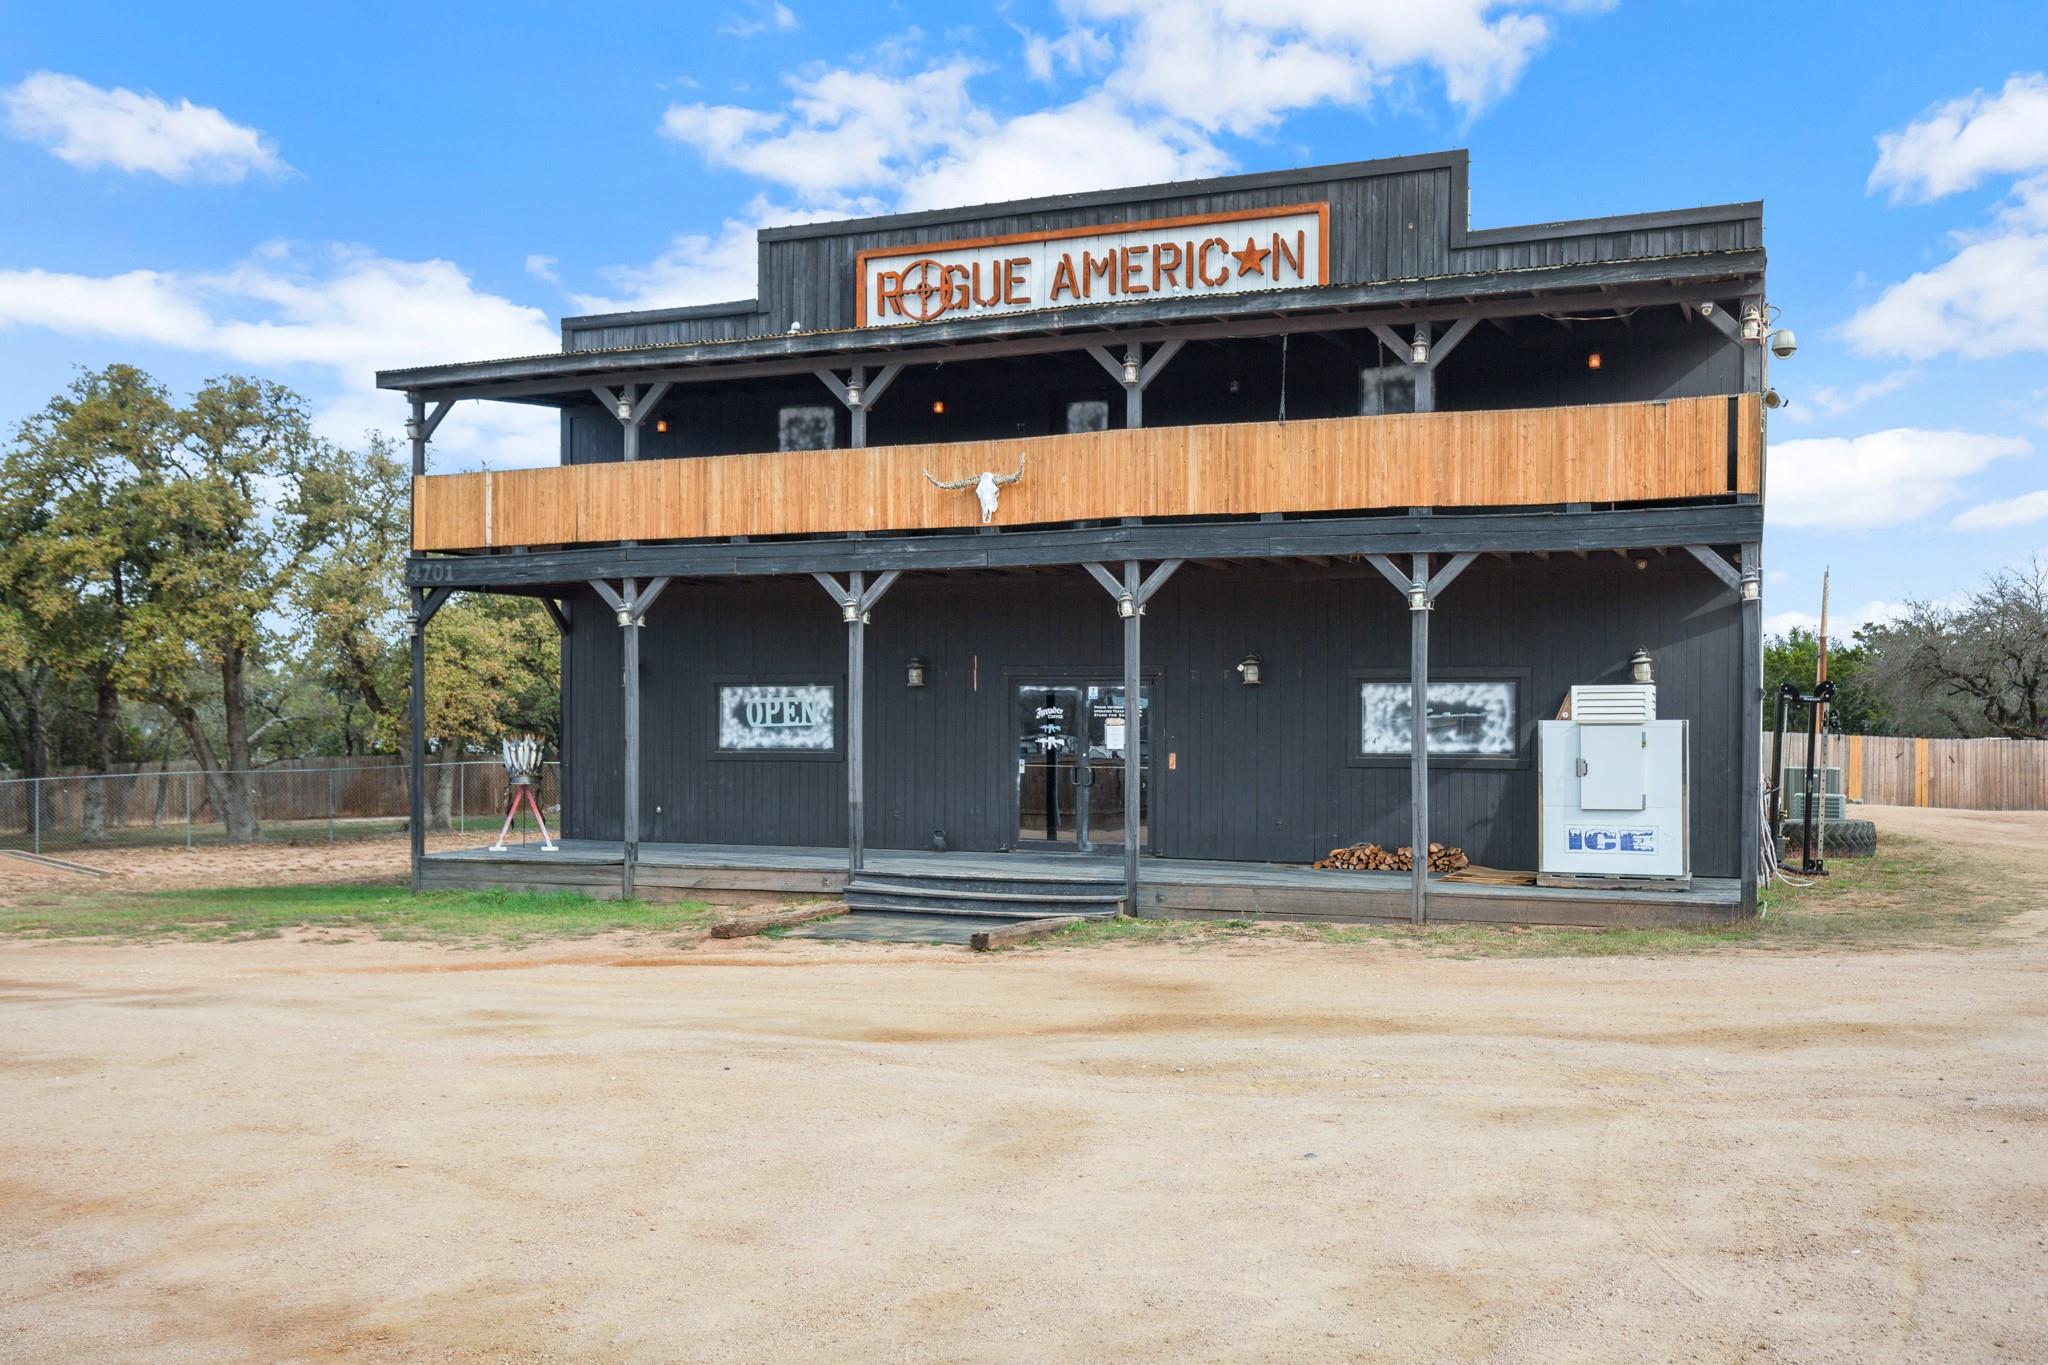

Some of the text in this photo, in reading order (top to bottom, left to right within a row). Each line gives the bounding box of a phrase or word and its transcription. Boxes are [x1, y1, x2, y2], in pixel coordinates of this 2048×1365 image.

[877, 256, 1032, 321] ROGUE
[409, 563, 455, 581] 4701
[746, 697, 816, 727] OPEN
[1568, 827, 1654, 853] ICE
